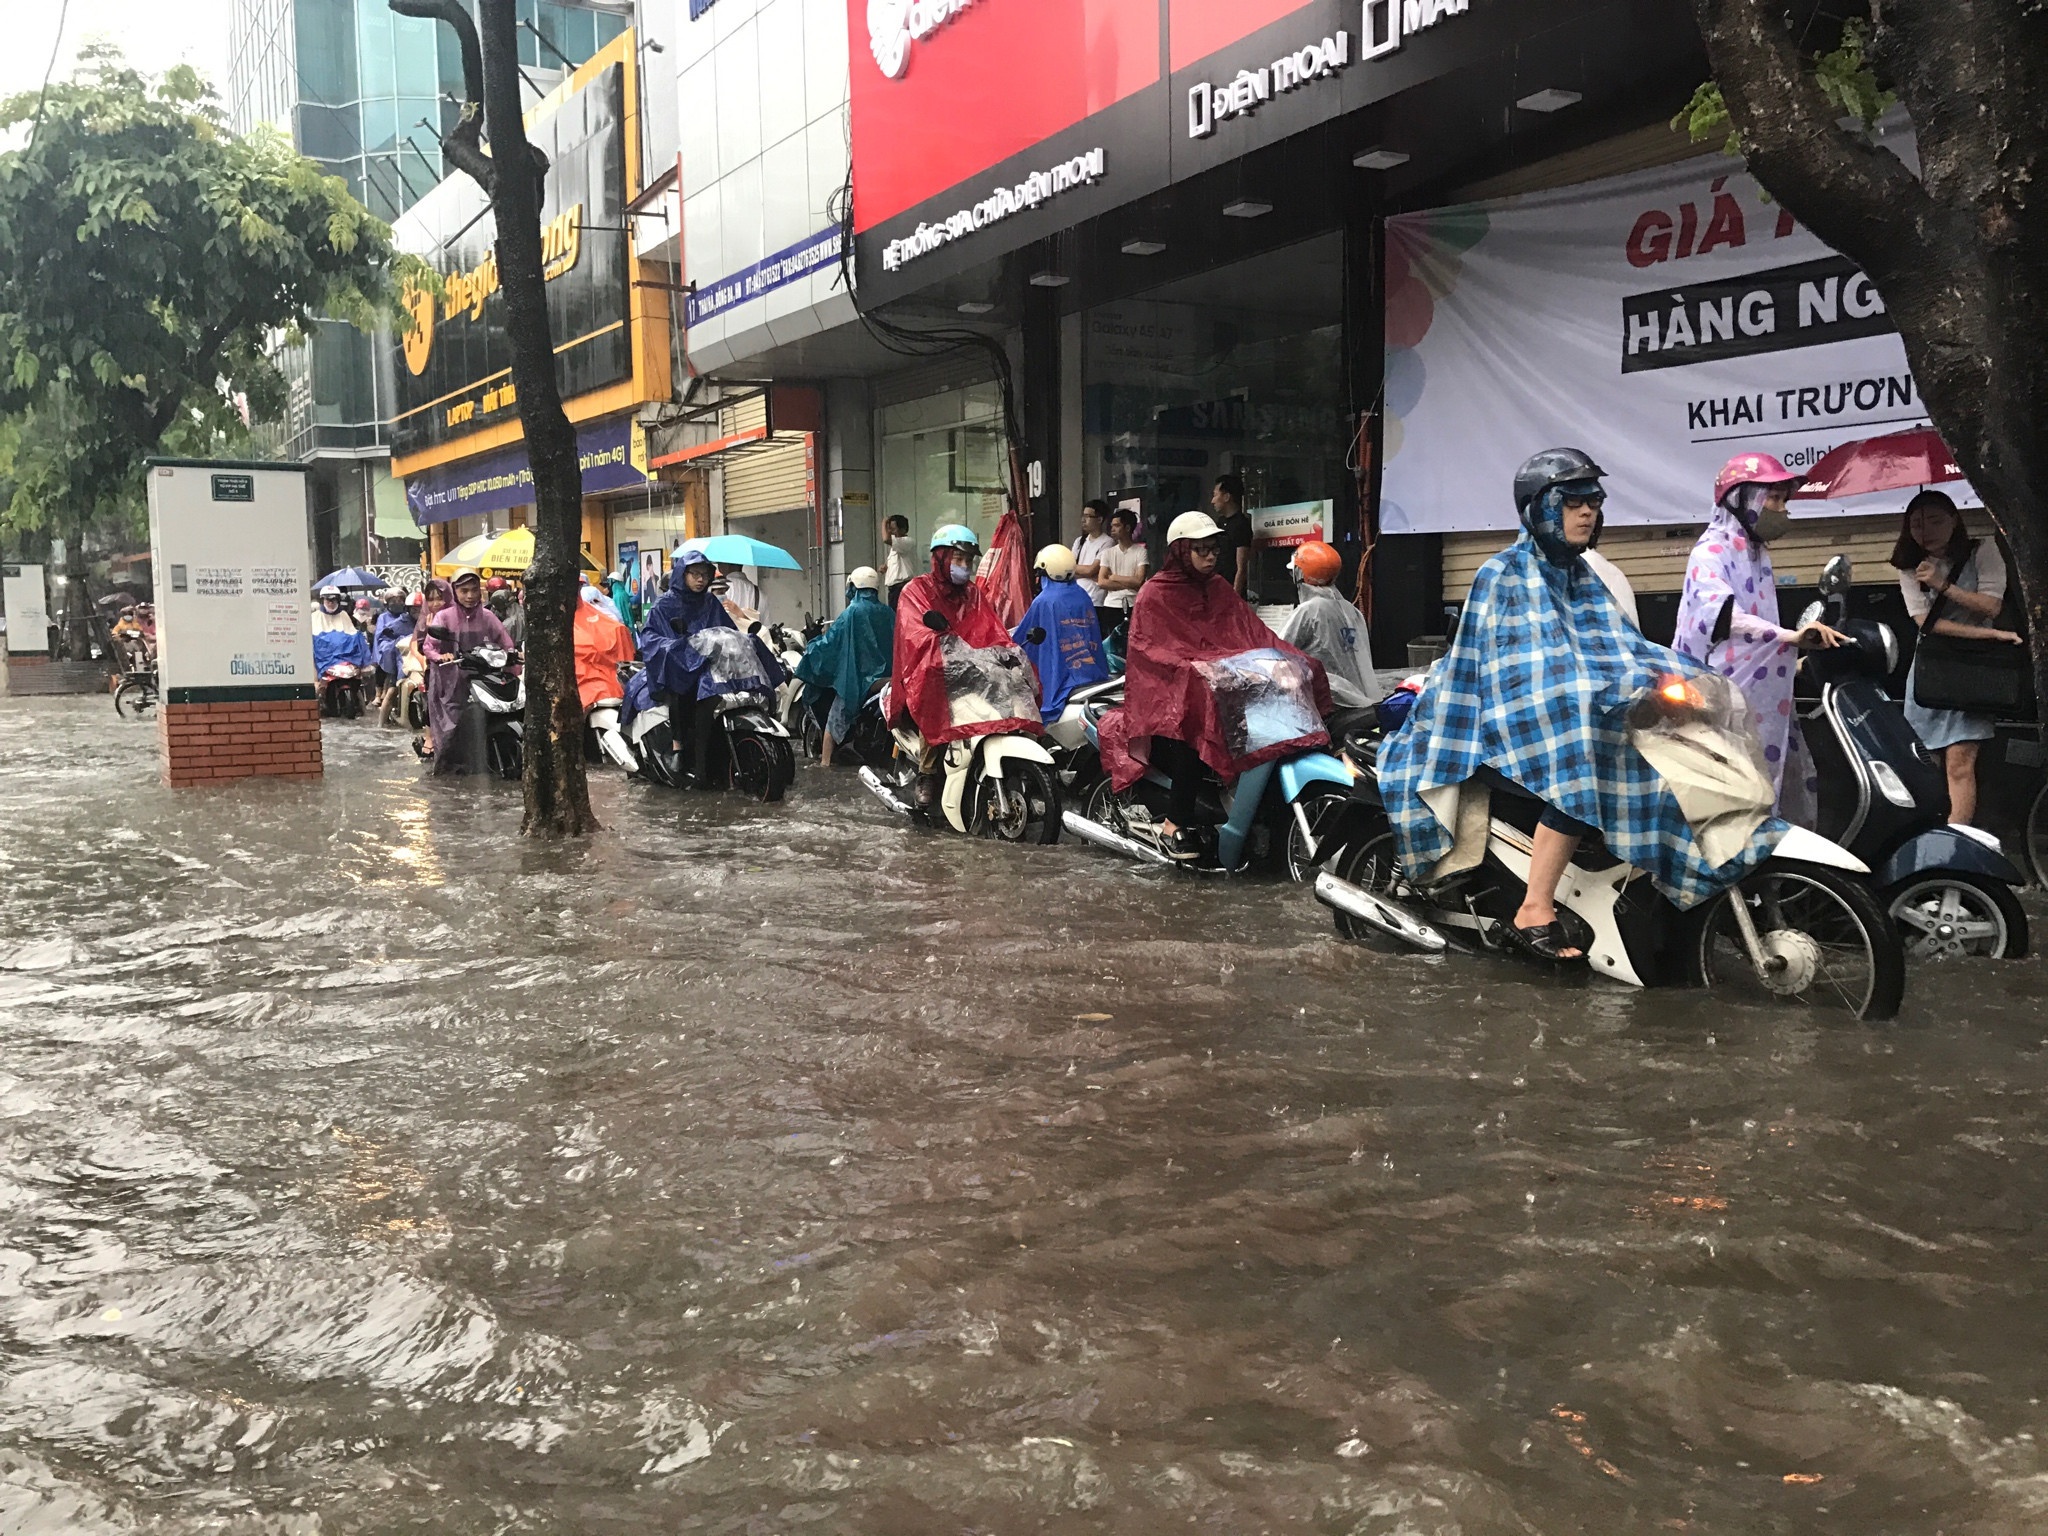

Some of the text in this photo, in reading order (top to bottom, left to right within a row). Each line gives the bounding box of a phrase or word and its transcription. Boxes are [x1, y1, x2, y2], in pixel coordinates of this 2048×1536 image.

[1212, 31, 1348, 119] ĐIỆN THOẠI
[883, 239, 901, 271] HỆ
[900, 222, 946, 262] THỐNG
[1015, 171, 1051, 209] ĐIỆN
[1051, 148, 1104, 193] THOẠI
[1625, 175, 1746, 268] GIÁ
[688, 299, 696, 323] 17
[1627, 271, 1886, 355] HÀNG NG
[447, 400, 475, 428] LAPTOP
[1687, 373, 1918, 430] KHAI TRƯƠN
[1784, 445, 1832, 467] cellp
[1026, 460, 1044, 499] 19
[1264, 520, 1276, 528] GIÁ
[1286, 517, 1300, 526] ĐÓN
[1279, 537, 1295, 546] SUẤT
